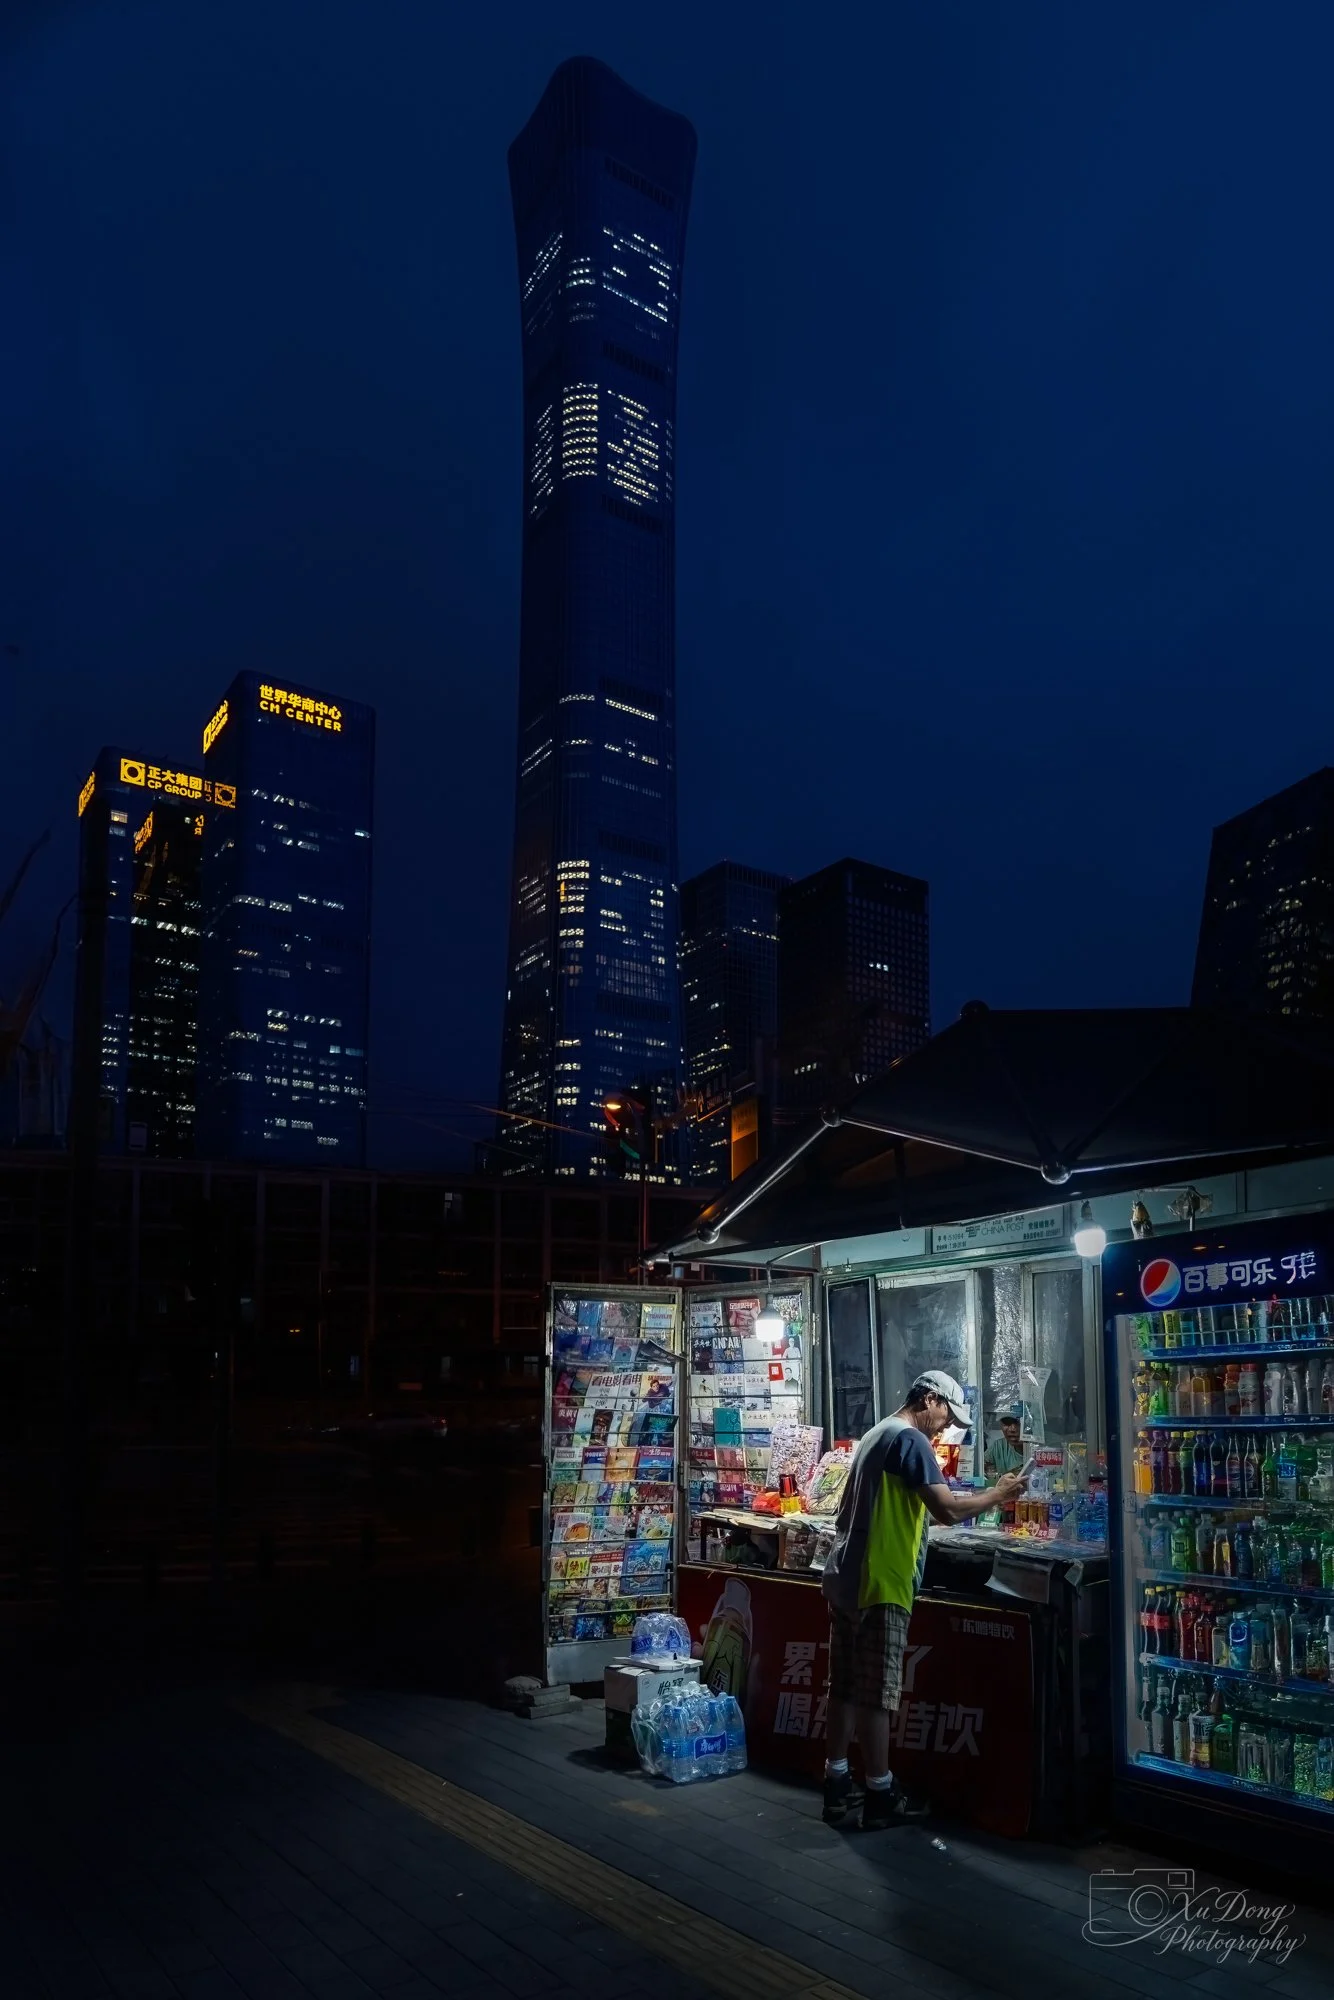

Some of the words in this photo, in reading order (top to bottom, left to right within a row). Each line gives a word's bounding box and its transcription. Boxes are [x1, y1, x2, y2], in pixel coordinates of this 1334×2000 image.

[259, 684, 342, 720] 世界华商中心
[259, 700, 280, 714] CM
[285, 707, 342, 732] CENTER
[147, 765, 203, 791] 正大集团
[147, 780, 162, 790] CP
[164, 783, 203, 799] GROUP
[981, 1224, 1005, 1236] CHINA
[1006, 1221, 1025, 1232] POST
[1182, 1257, 1278, 1293] 百事可乐
[592, 1373, 621, 1387] 看电影
[772, 1691, 984, 1757] 喝特饮
